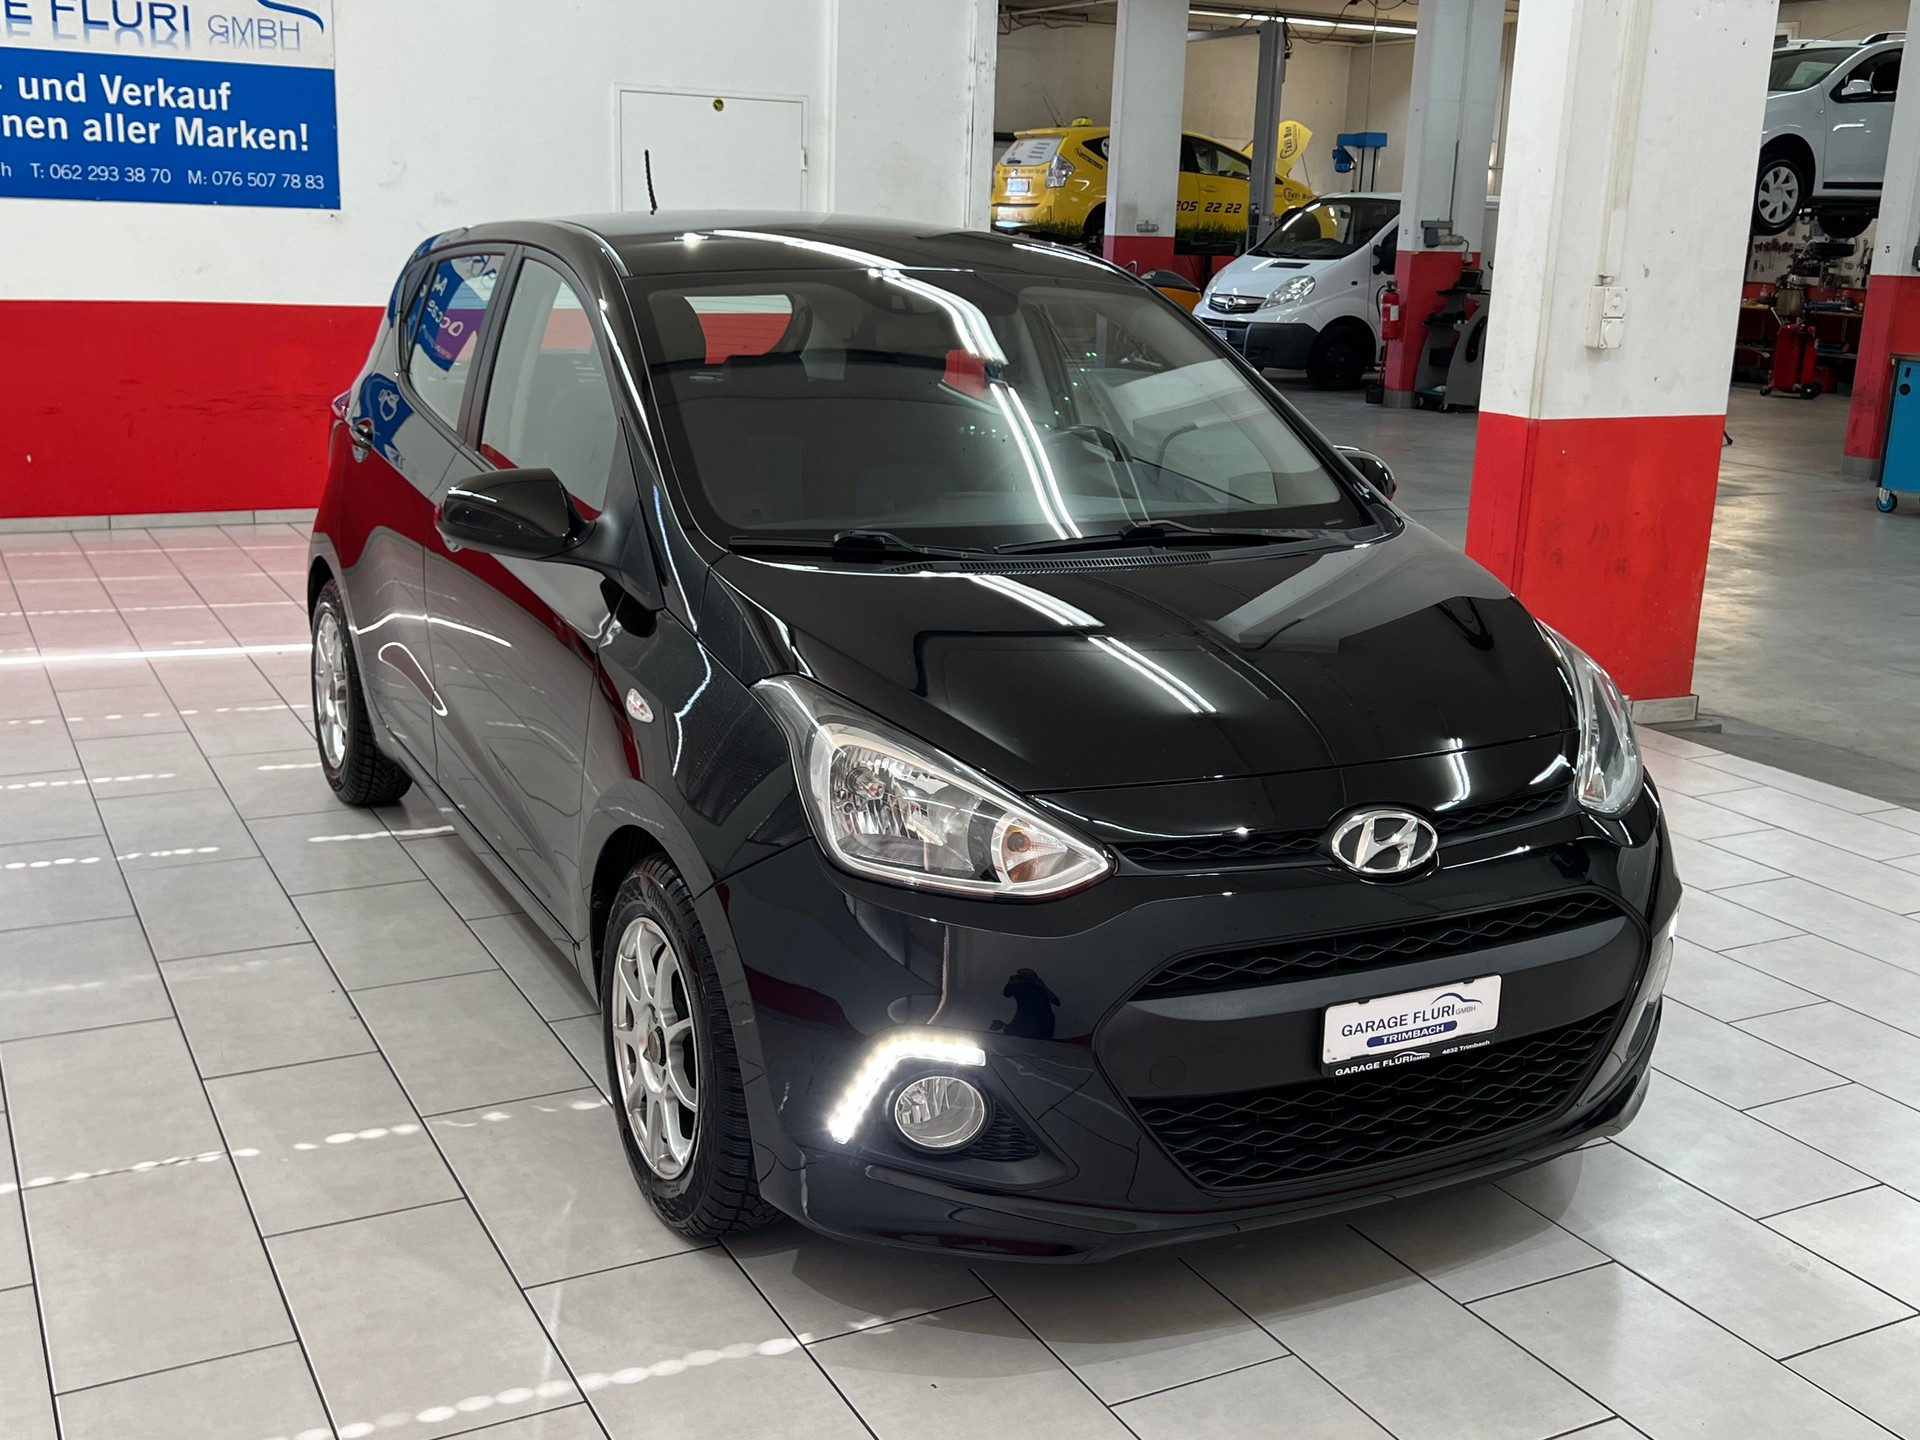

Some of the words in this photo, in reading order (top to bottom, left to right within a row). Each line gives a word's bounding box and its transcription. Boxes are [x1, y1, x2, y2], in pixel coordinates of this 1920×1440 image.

[51, 0, 190, 32] FLURI
[208, 15, 299, 41] GMBH
[18, 72, 86, 103] und
[99, 73, 231, 111] Verkauf
[83, 112, 161, 144] aller
[175, 116, 308, 152] Marken!
[30, 163, 45, 179] T:
[50, 163, 82, 180] 062
[88, 165, 119, 182] 293
[124, 167, 146, 183] 38
[150, 168, 172, 184] 70
[187, 170, 208, 185] M:
[212, 170, 243, 186] 076
[247, 172, 276, 188] 507
[281, 173, 300, 189] 78
[305, 174, 325, 190] 83
[1204, 202, 1222, 213] 22
[1224, 203, 1242, 214] 22
[1341, 1013, 1408, 1038] GARAGE
[1413, 1003, 1455, 1025] FLURI
[1455, 1005, 1476, 1016] GMBH
[1381, 1023, 1445, 1044] TRIMBACH
[1459, 1039, 1491, 1052] Trimbach
[1334, 1060, 1381, 1077] GARAGE
[1383, 1054, 1413, 1068] FLURI
